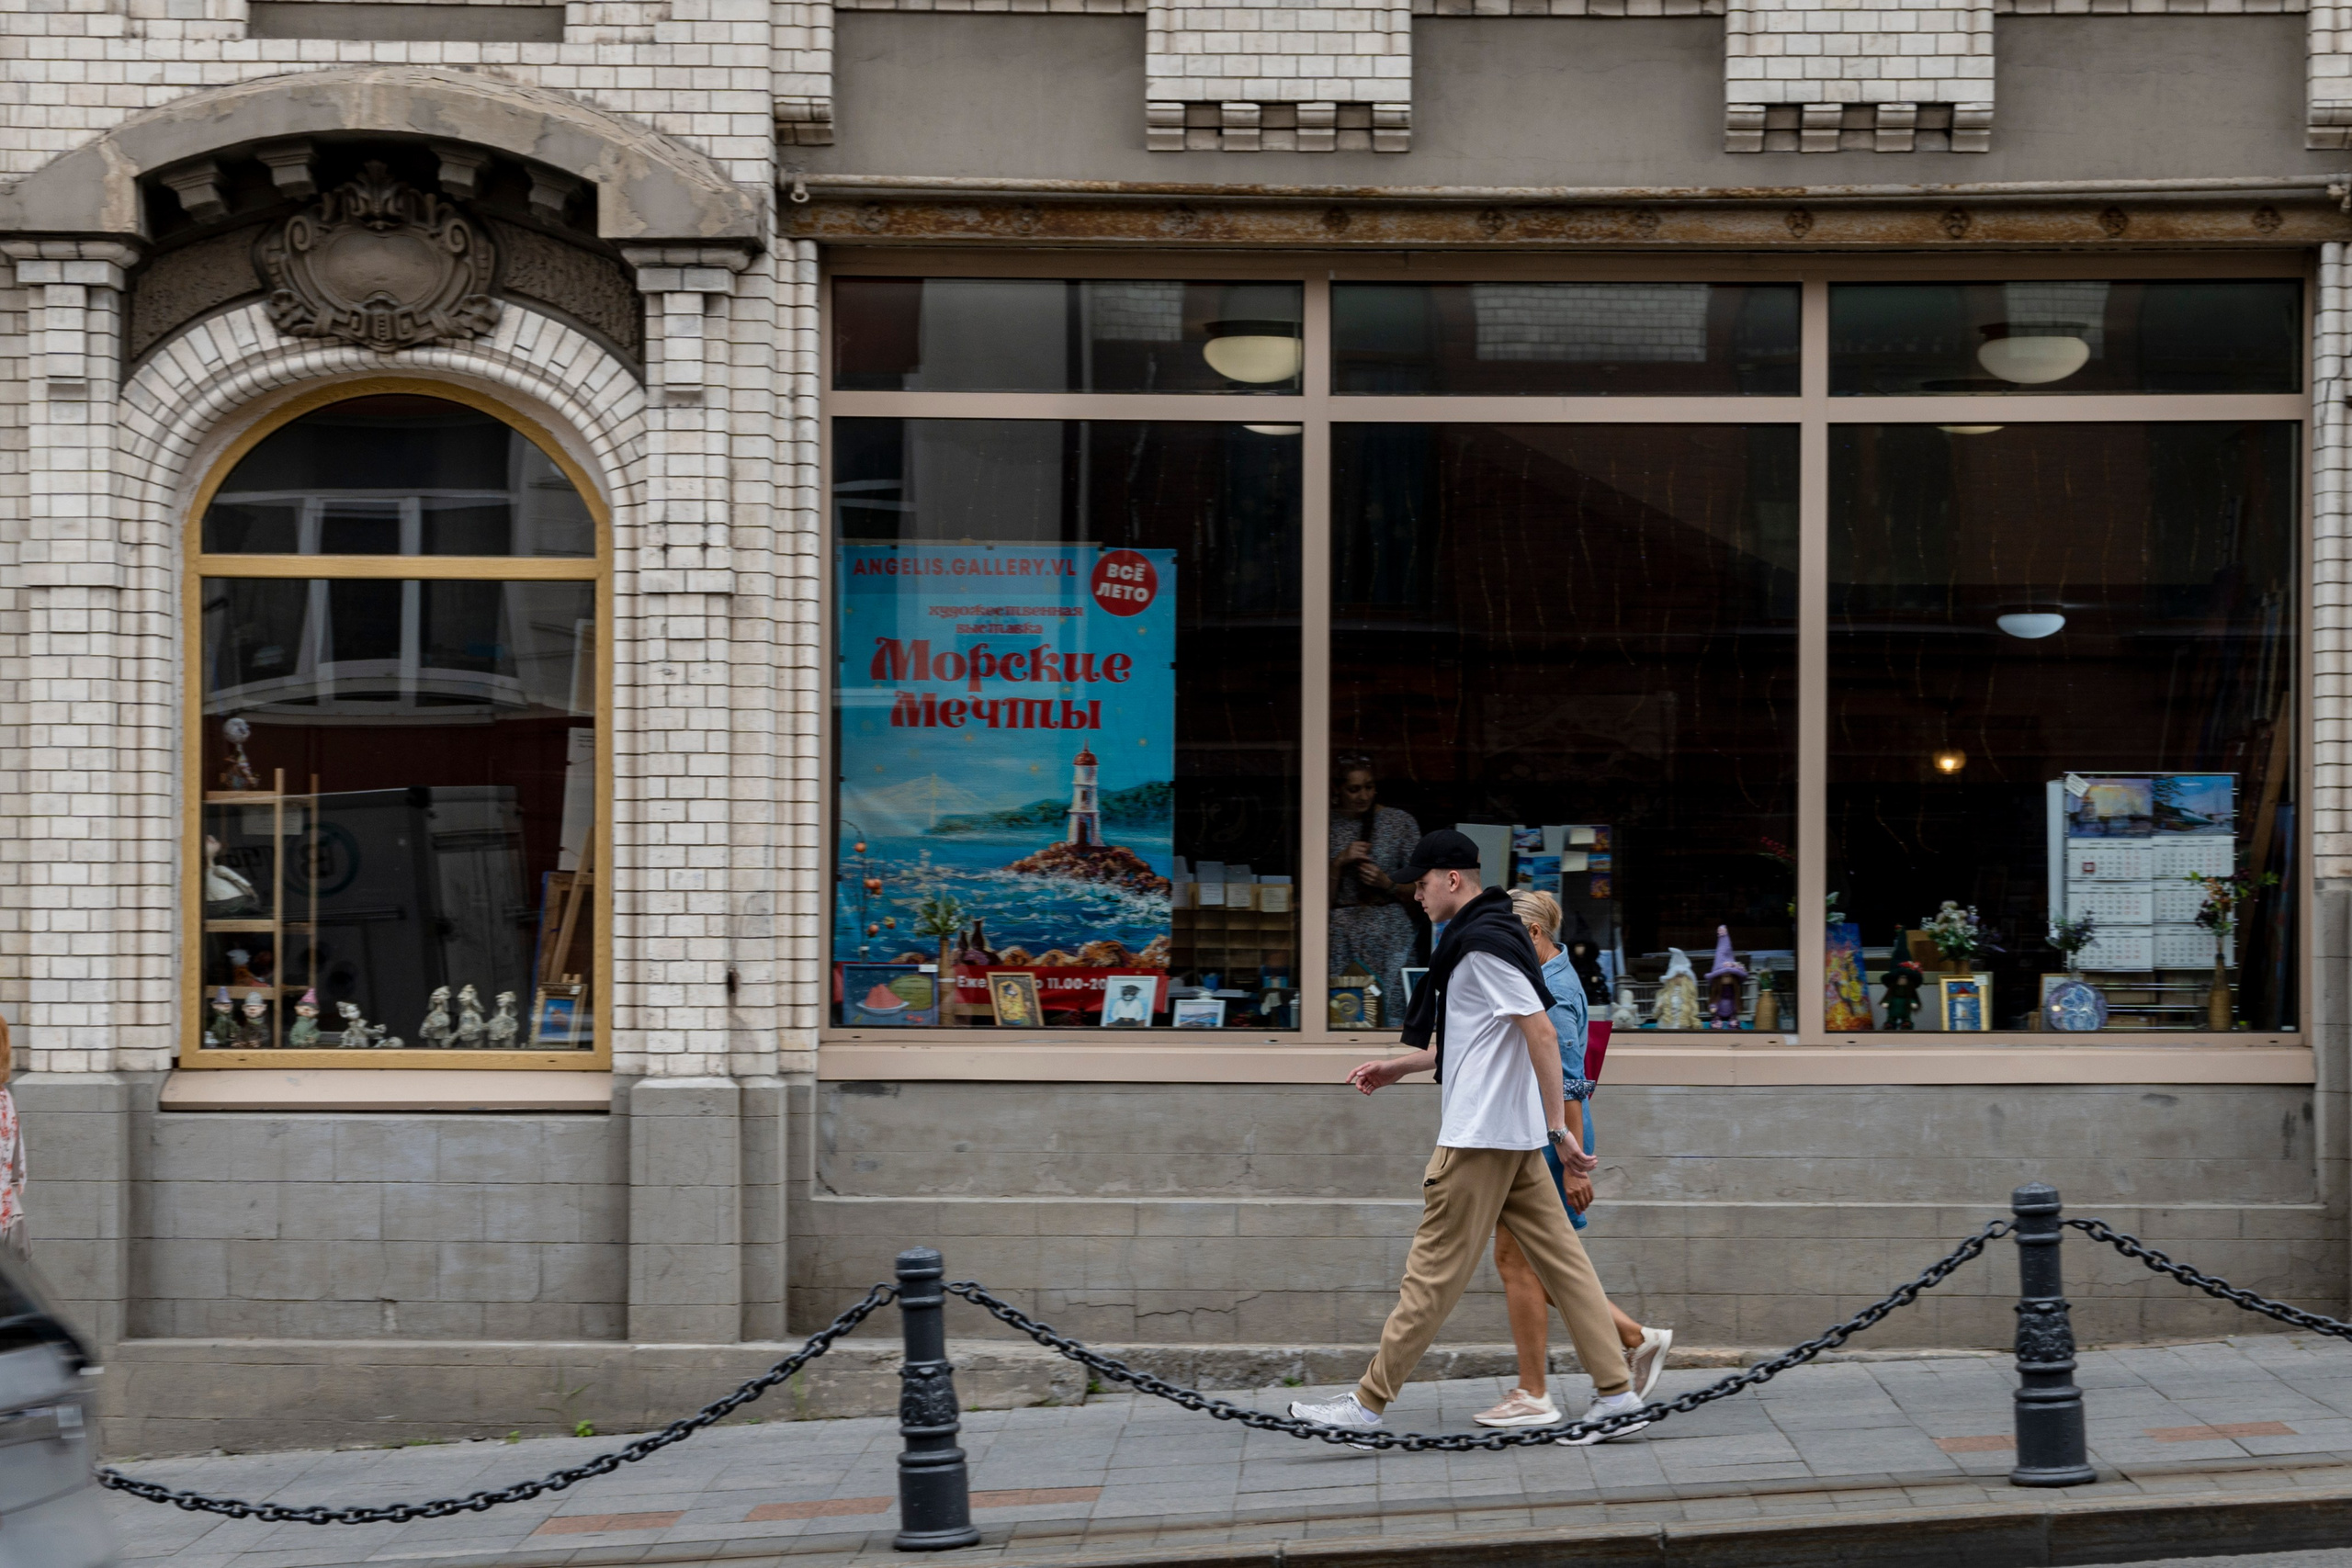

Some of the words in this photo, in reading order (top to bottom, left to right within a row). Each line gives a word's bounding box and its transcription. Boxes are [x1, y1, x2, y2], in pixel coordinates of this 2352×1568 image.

[853, 558, 1078, 577] ANGELIS.GALLERY.VL
[1105, 563, 1146, 582] ВСЁ
[1095, 581, 1149, 603] ЛЕТО
[869, 636, 1133, 693] Морские
